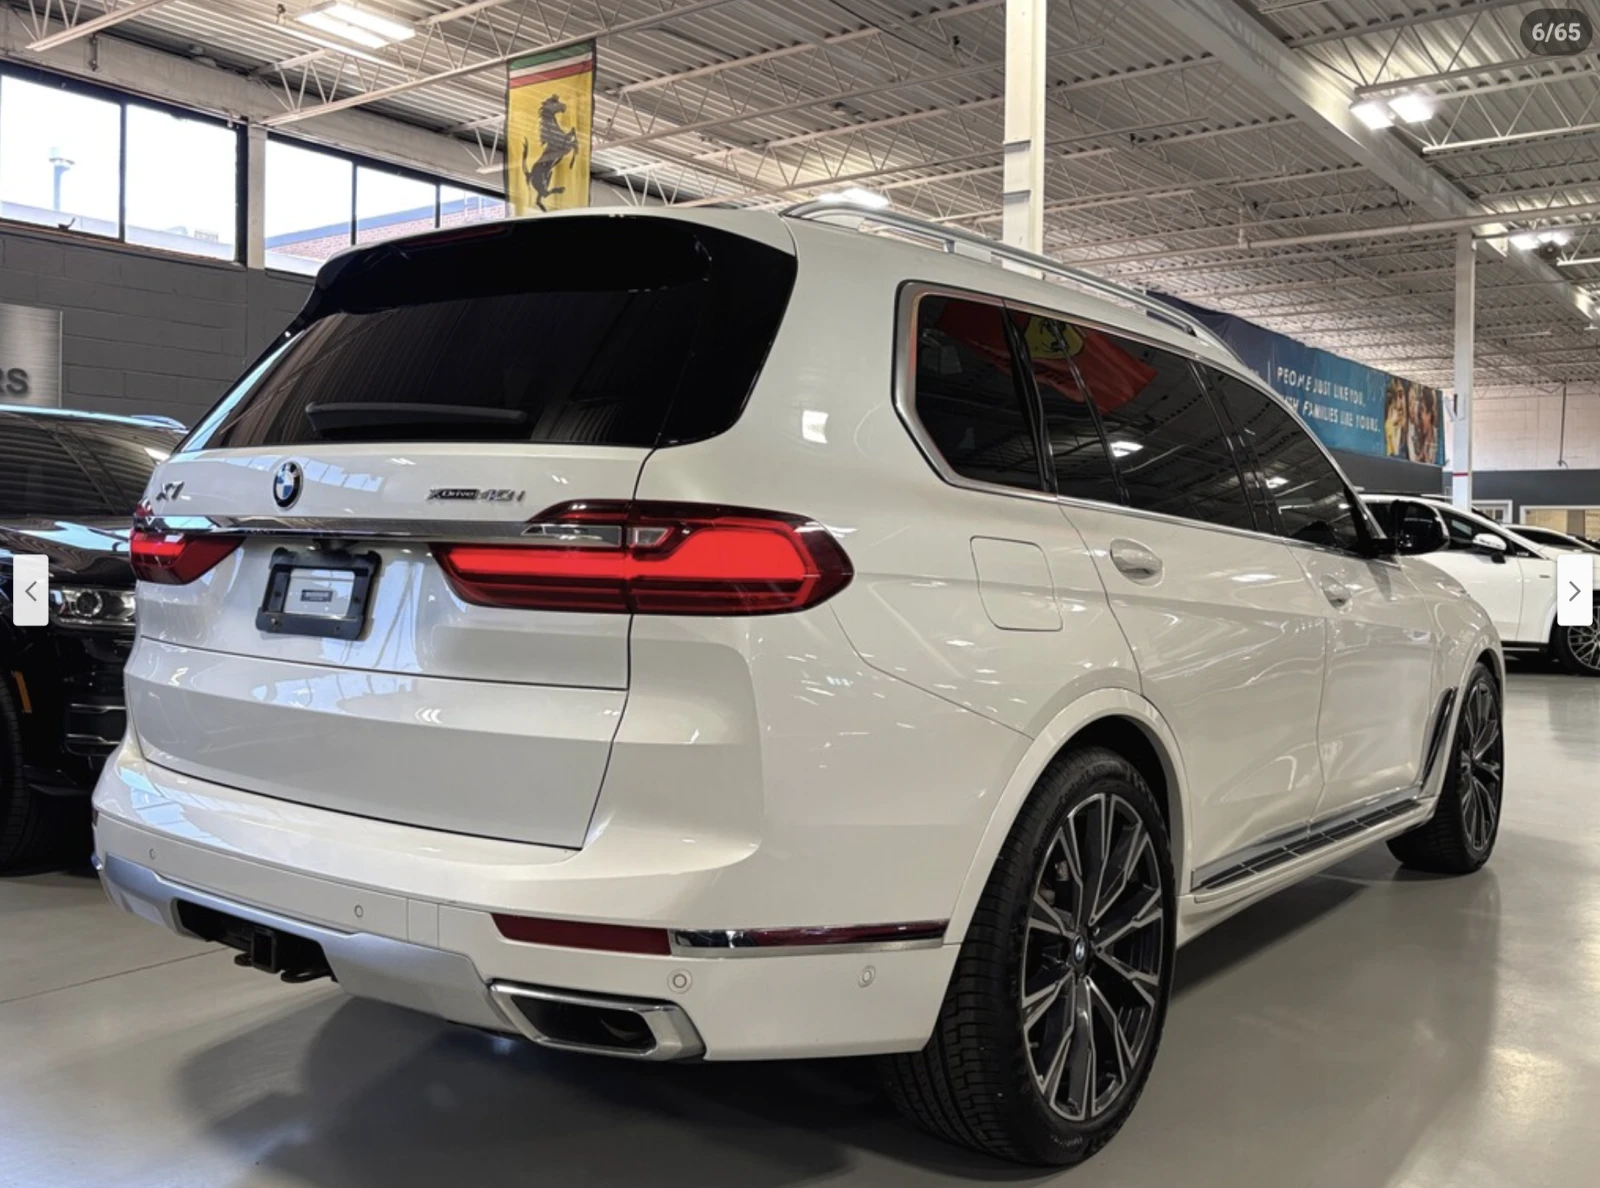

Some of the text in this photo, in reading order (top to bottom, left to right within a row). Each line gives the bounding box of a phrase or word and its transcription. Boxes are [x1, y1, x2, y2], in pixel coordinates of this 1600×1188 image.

[0, 367, 29, 395] S
[1313, 378, 1331, 396] JUST
[1333, 383, 1348, 401] LIKE
[1302, 400, 1338, 423] FAMILIES
[155, 481, 185, 502] X7
